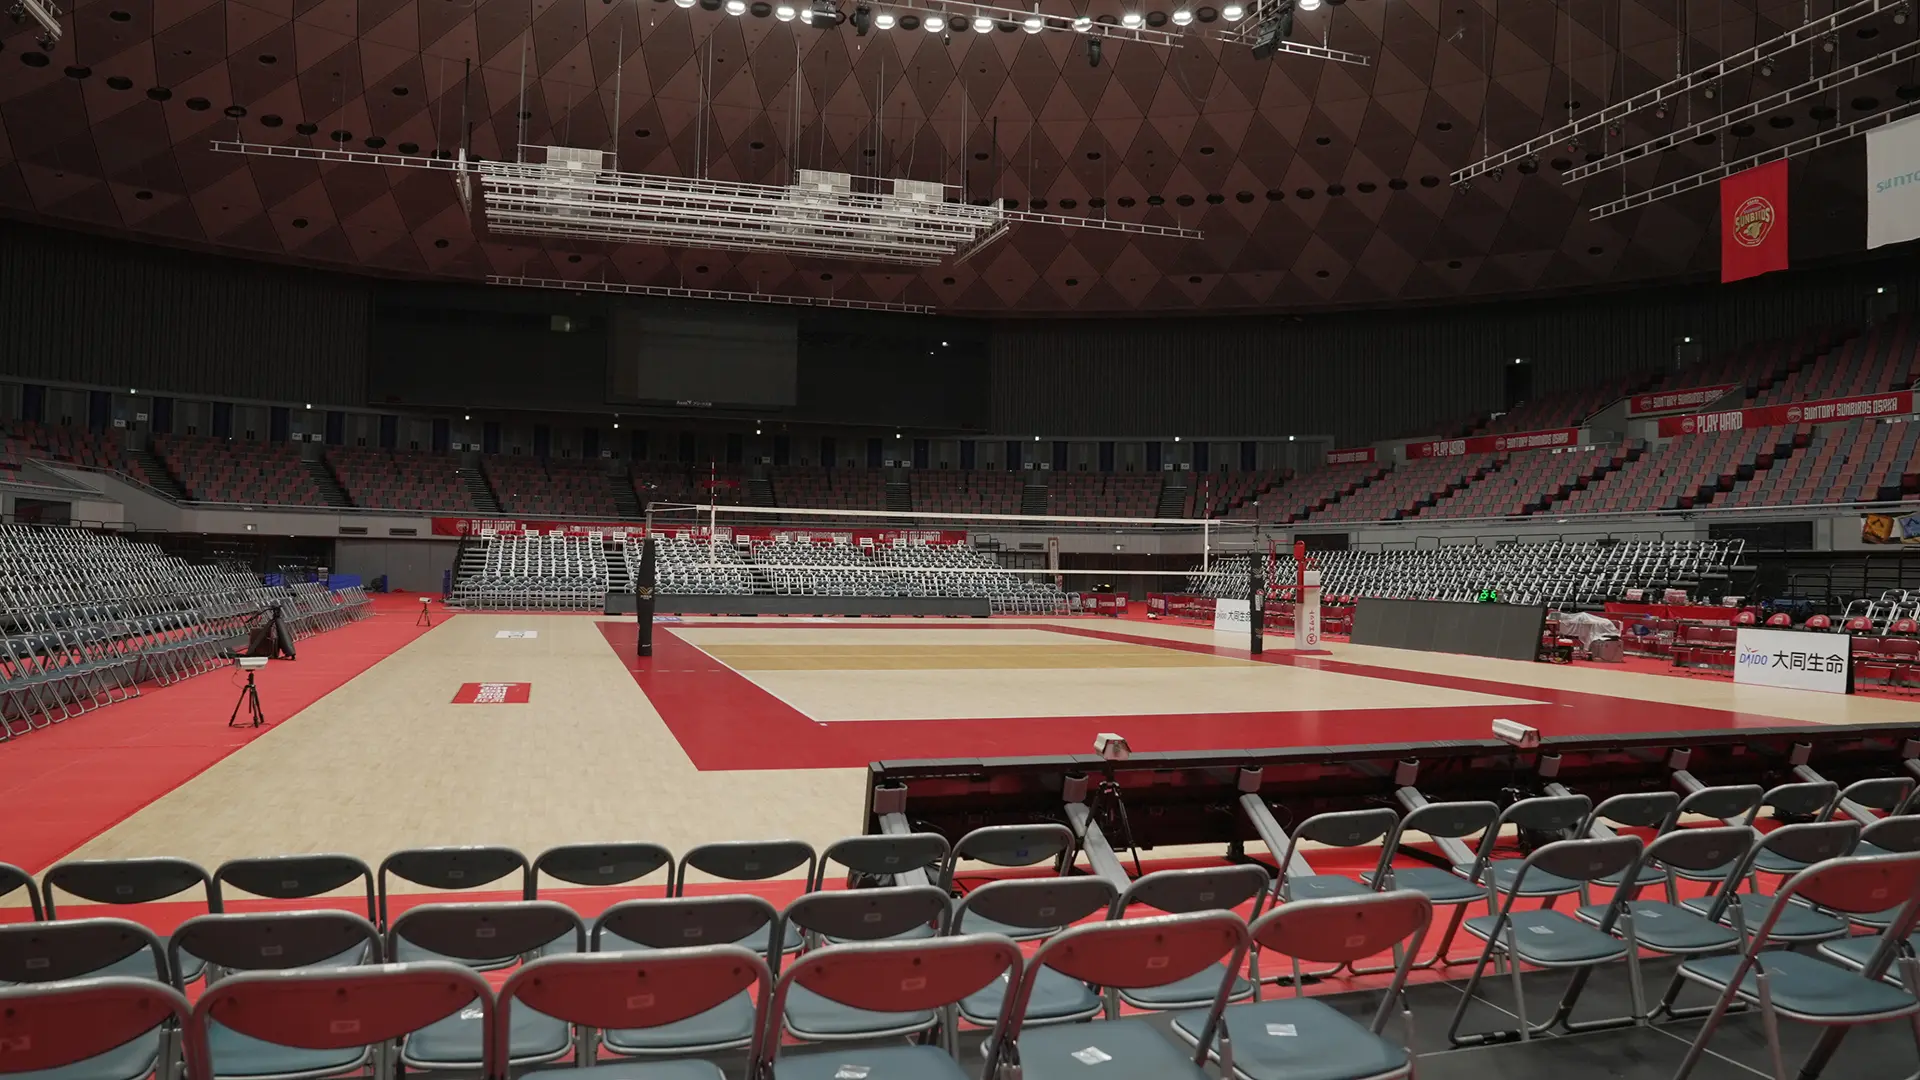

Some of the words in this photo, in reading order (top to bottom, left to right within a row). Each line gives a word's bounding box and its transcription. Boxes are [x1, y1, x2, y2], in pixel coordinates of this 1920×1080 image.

[1804, 404, 1835, 420] SUNTORY
[1836, 400, 1872, 417] SUNBIRDS
[1872, 397, 1898, 413] OSAKA
[1697, 414, 1719, 433] PLAY
[1719, 411, 1743, 432] HARD
[1739, 653, 1768, 667] DAIDO
[1772, 650, 1844, 674] 大同生命
